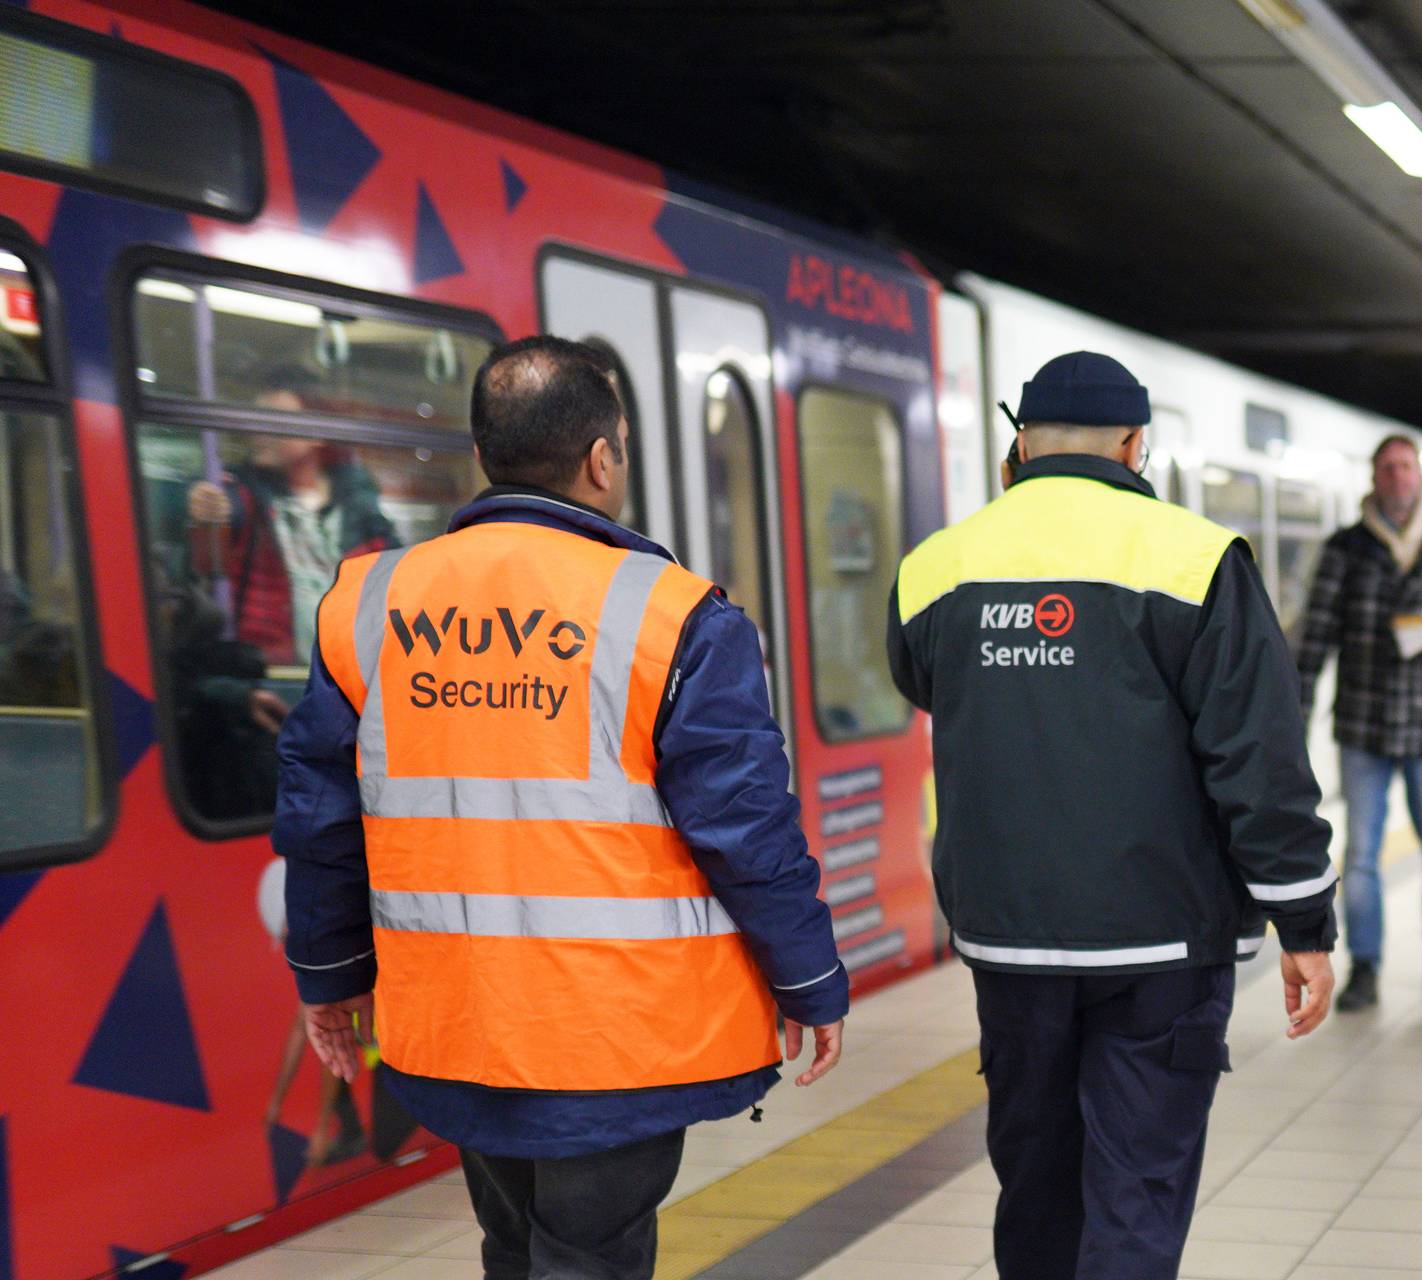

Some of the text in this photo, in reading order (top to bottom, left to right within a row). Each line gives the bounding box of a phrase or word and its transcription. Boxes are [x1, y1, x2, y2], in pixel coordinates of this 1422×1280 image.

[388, 606, 586, 660] WuVo
[980, 603, 1035, 629] KVB
[980, 640, 1075, 667] Service
[409, 671, 568, 721] Security
